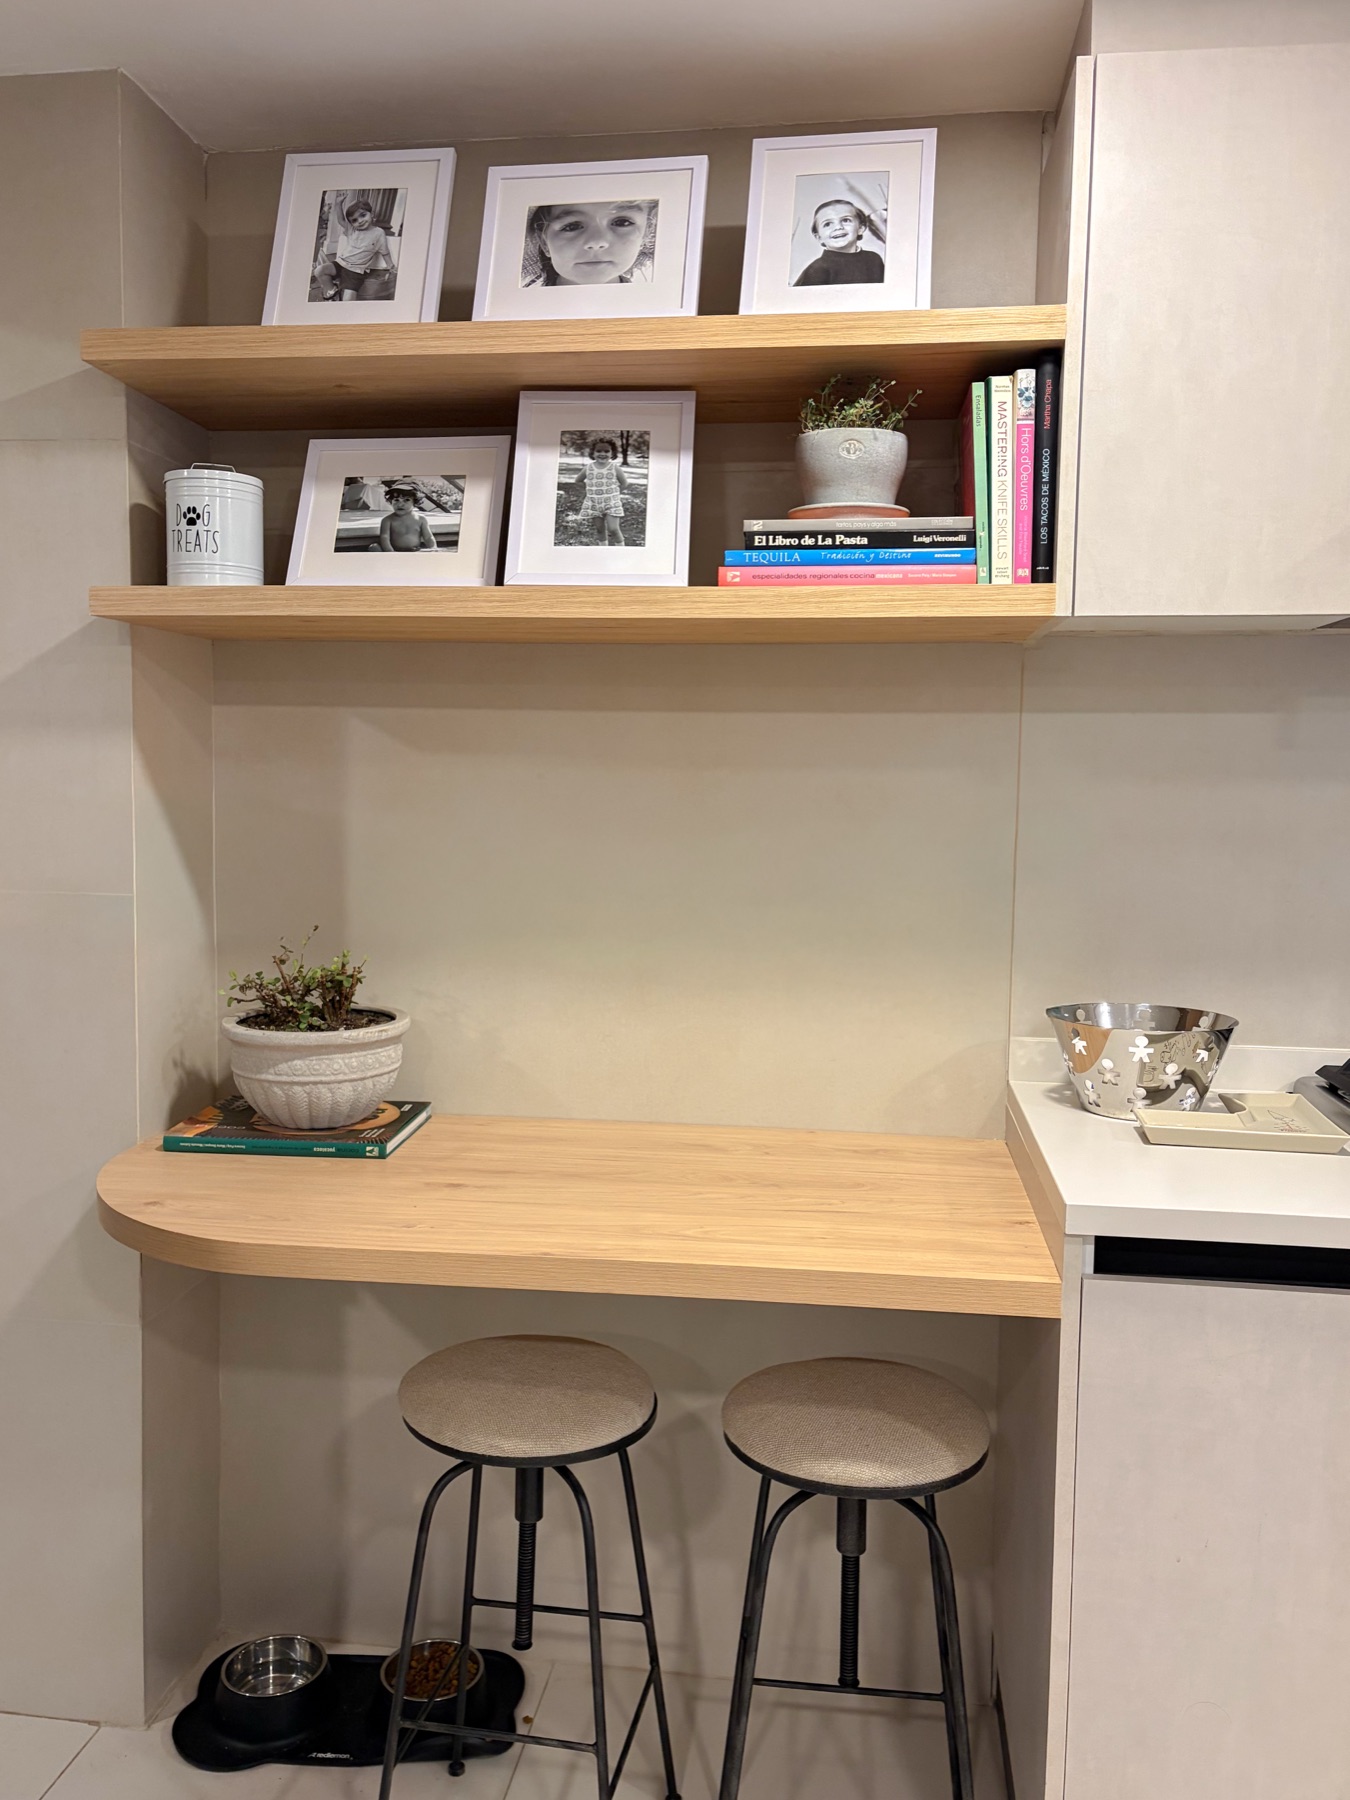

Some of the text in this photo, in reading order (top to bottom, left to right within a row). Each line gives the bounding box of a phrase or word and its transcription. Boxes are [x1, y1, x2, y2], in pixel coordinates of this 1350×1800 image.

[1043, 379, 1053, 430] Martha Chapa
[997, 401, 1008, 478] MASTERING
[1020, 427, 1032, 454] Hors
[997, 480, 1008, 516] KNIFE
[1020, 458, 1032, 511] d'Oeuvres
[1040, 448, 1050, 544] LOS TACOS DE MÉXICO
[171, 529, 220, 554] TREATS
[754, 534, 868, 546] El Libro de La Pasta
[913, 534, 967, 543] Luigi Veronelli
[997, 518, 1008, 560] SKILLS
[743, 552, 801, 564] TEQUILA
[820, 550, 912, 563] Tradición y Destino
[752, 572, 808, 580] especialidades
[809, 572, 848, 581] regionales
